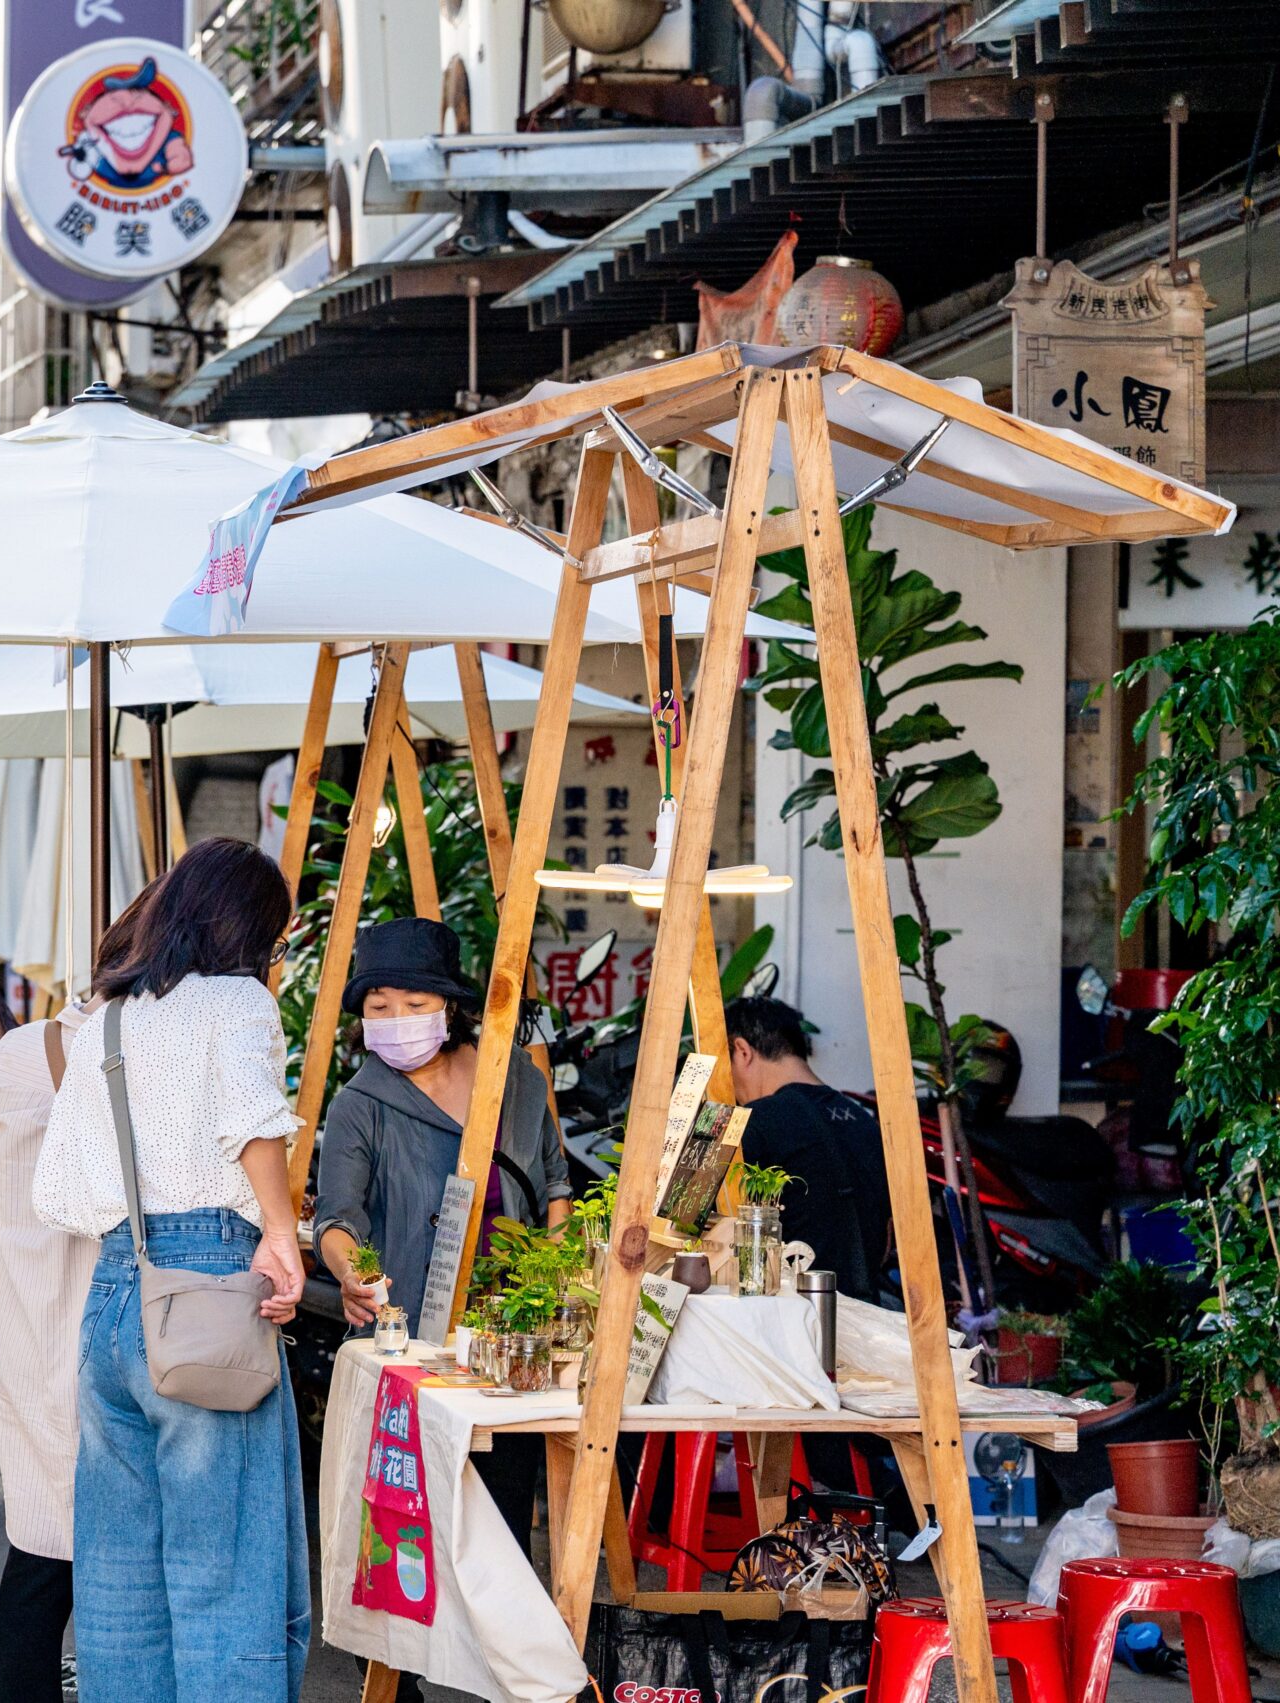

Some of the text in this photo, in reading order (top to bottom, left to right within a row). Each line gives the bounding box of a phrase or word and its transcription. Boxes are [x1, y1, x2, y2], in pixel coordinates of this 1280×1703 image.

[1069, 295, 1150, 315] 新民老街
[1052, 370, 1172, 434] 小鳳
[614, 1681, 721, 1703] COSTC
